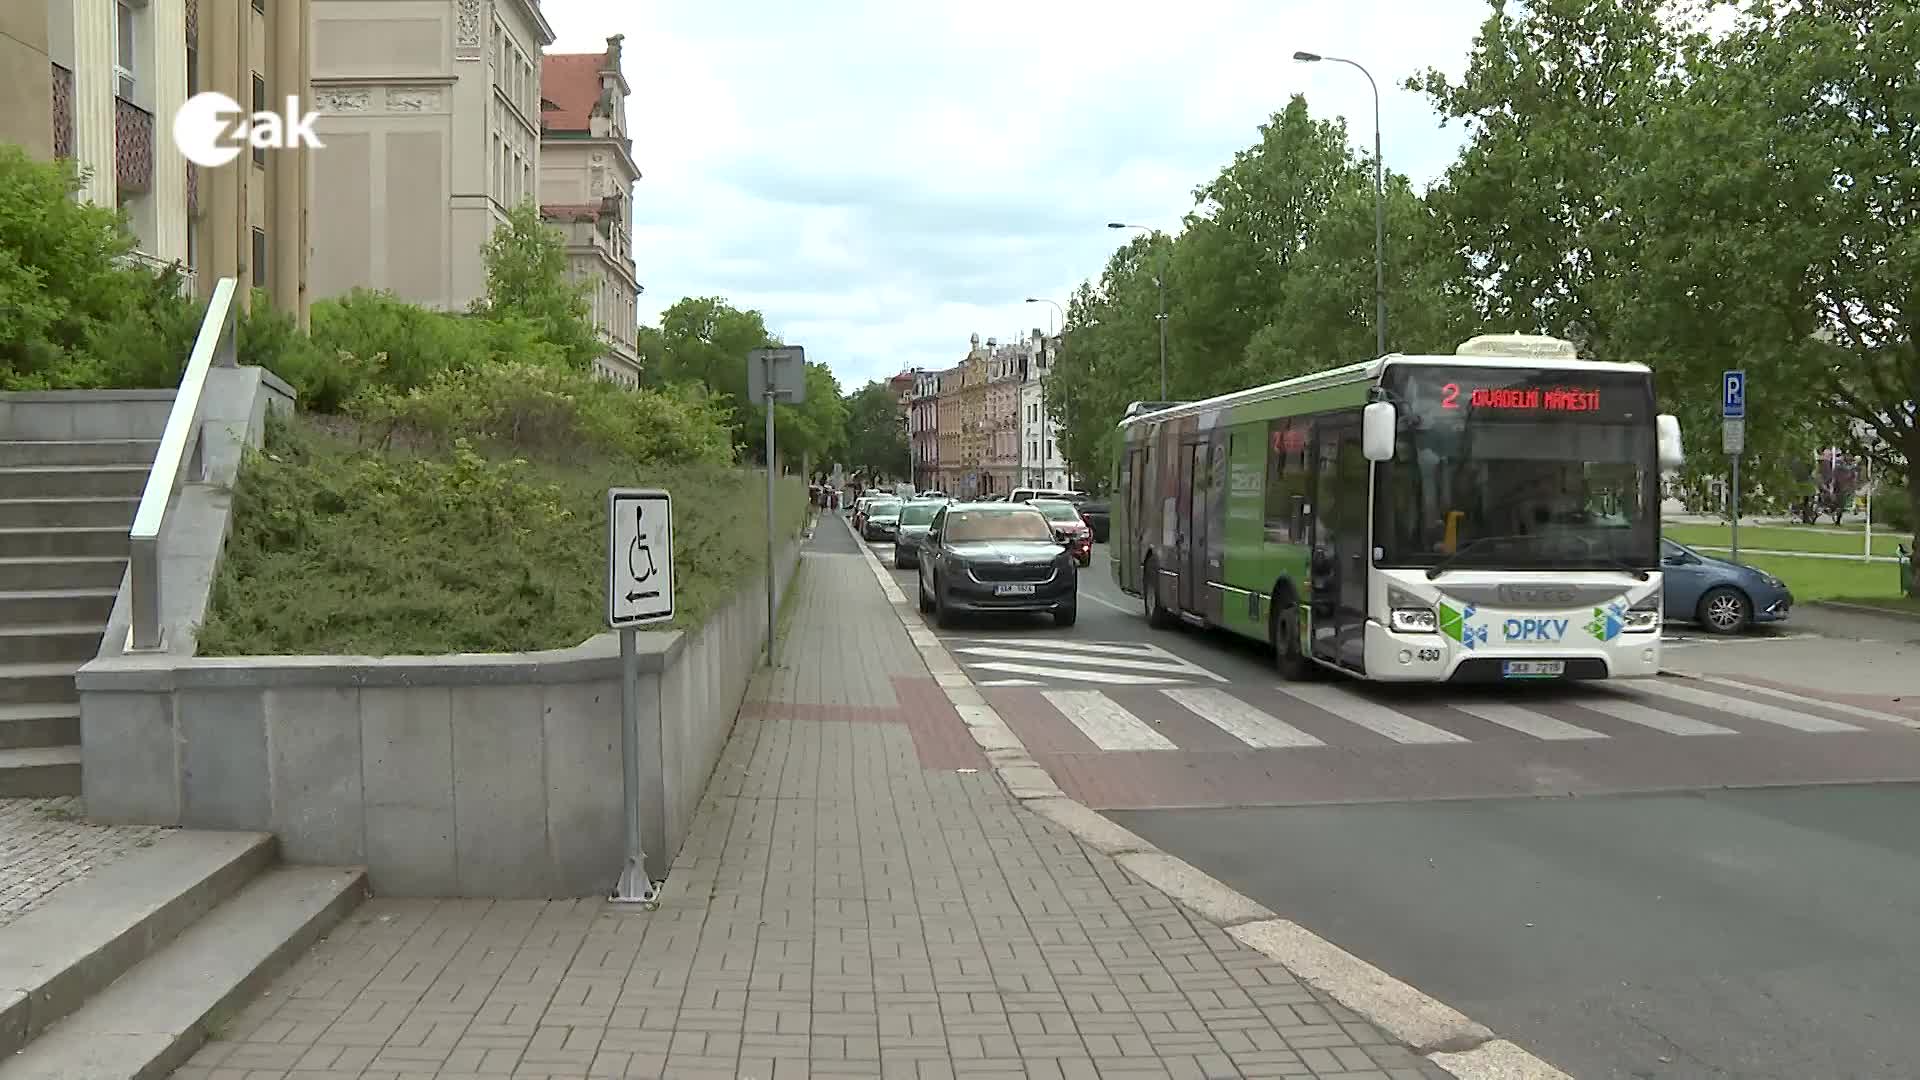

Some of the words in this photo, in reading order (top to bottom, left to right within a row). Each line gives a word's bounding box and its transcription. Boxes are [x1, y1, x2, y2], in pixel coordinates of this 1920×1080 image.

[1441, 383, 1460, 408] 2
[1727, 377, 1740, 404] P
[1505, 619, 1569, 640] DPKV
[1417, 647, 1440, 657] 430
